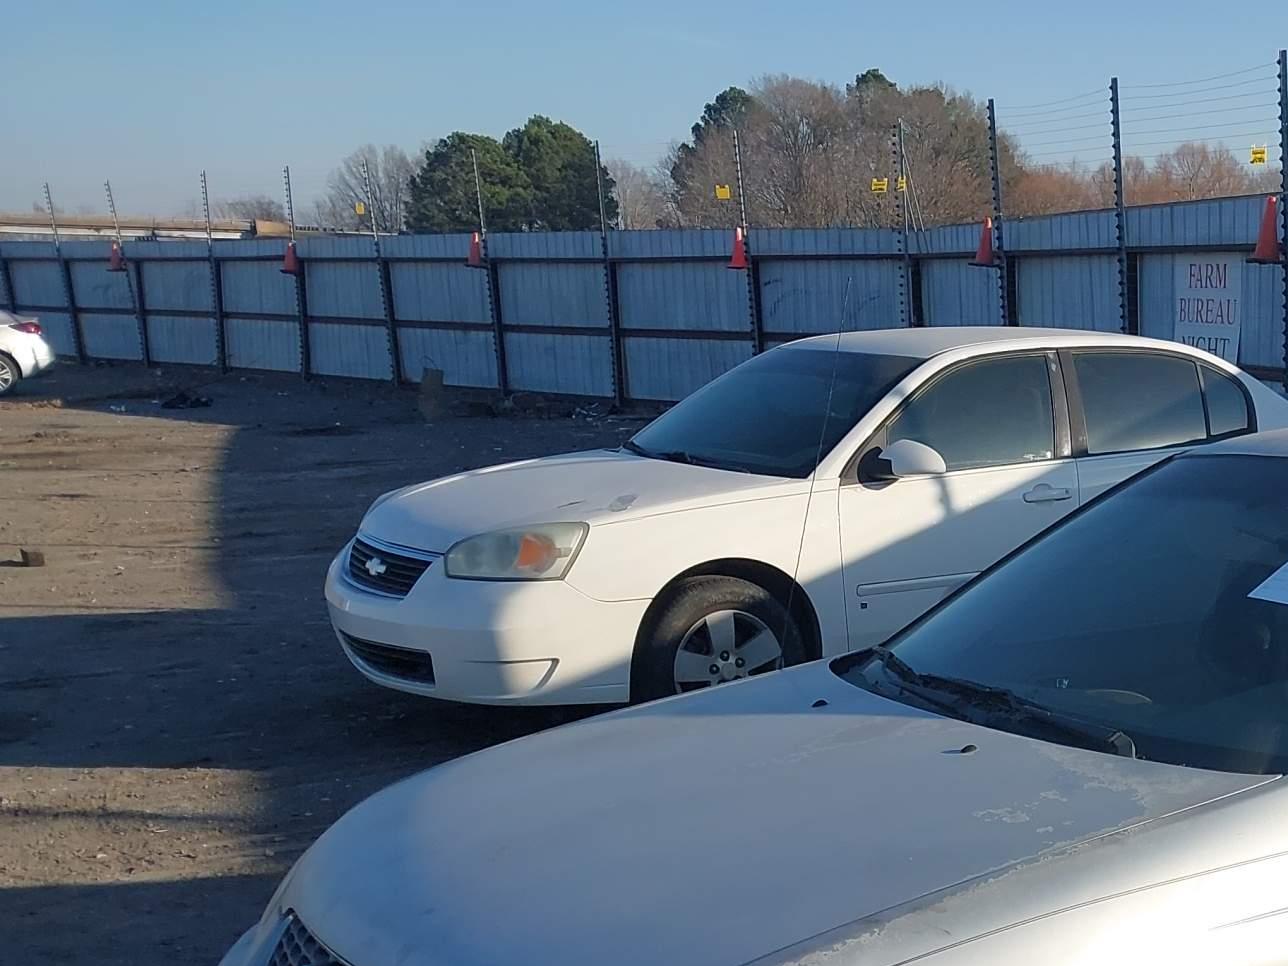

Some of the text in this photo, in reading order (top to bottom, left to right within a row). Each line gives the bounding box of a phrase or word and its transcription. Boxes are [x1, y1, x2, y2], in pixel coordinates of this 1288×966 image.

[1188, 263, 1227, 289] FARM
[1179, 297, 1237, 325] BUREAU
[1182, 335, 1231, 359] GHT
